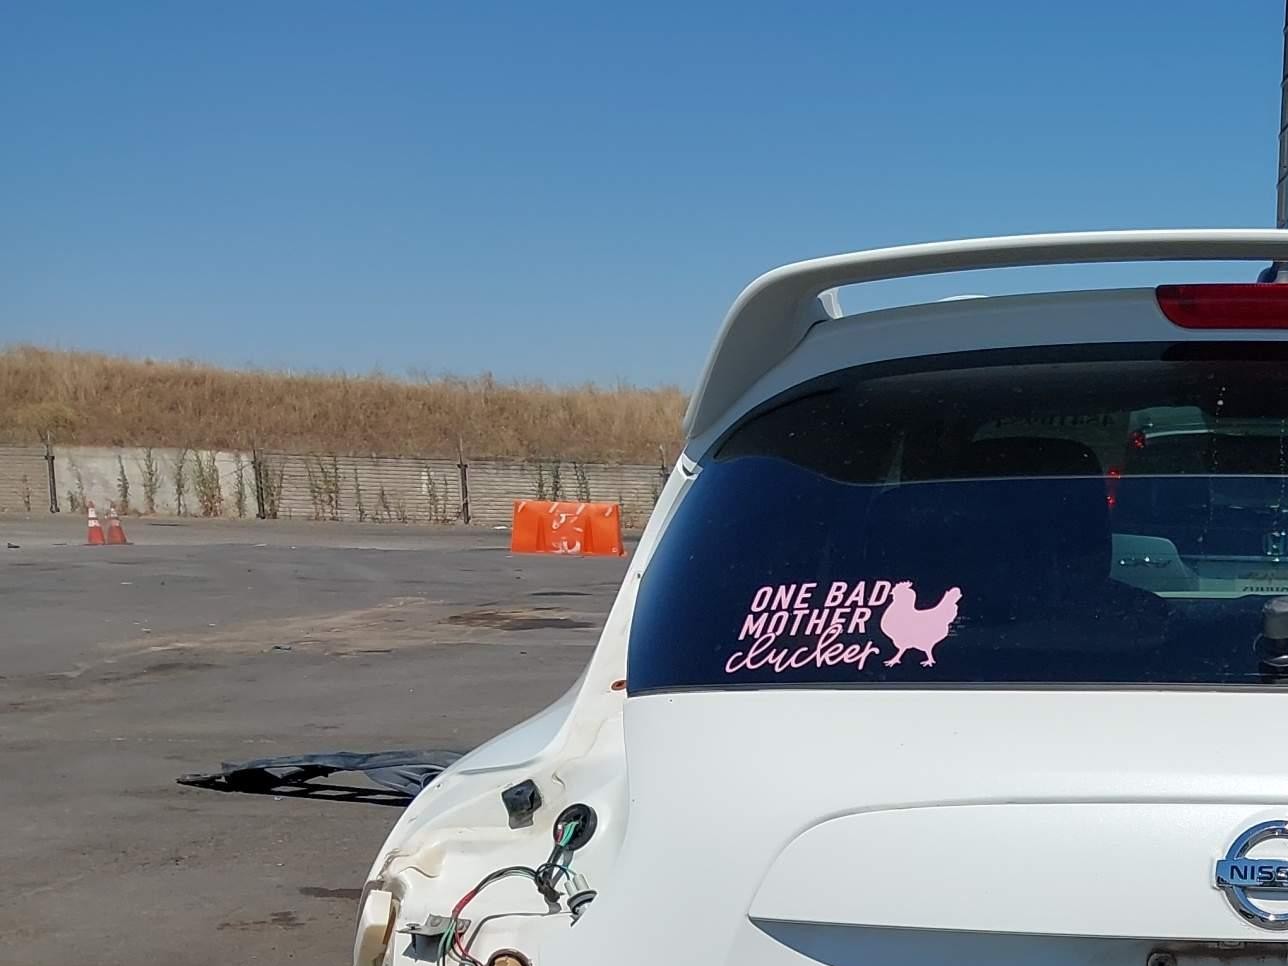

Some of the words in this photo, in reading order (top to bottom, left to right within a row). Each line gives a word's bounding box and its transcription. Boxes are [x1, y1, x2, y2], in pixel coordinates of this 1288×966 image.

[750, 582, 817, 613] ONE
[823, 580, 892, 609] BAD
[737, 607, 872, 640] MOTHER
